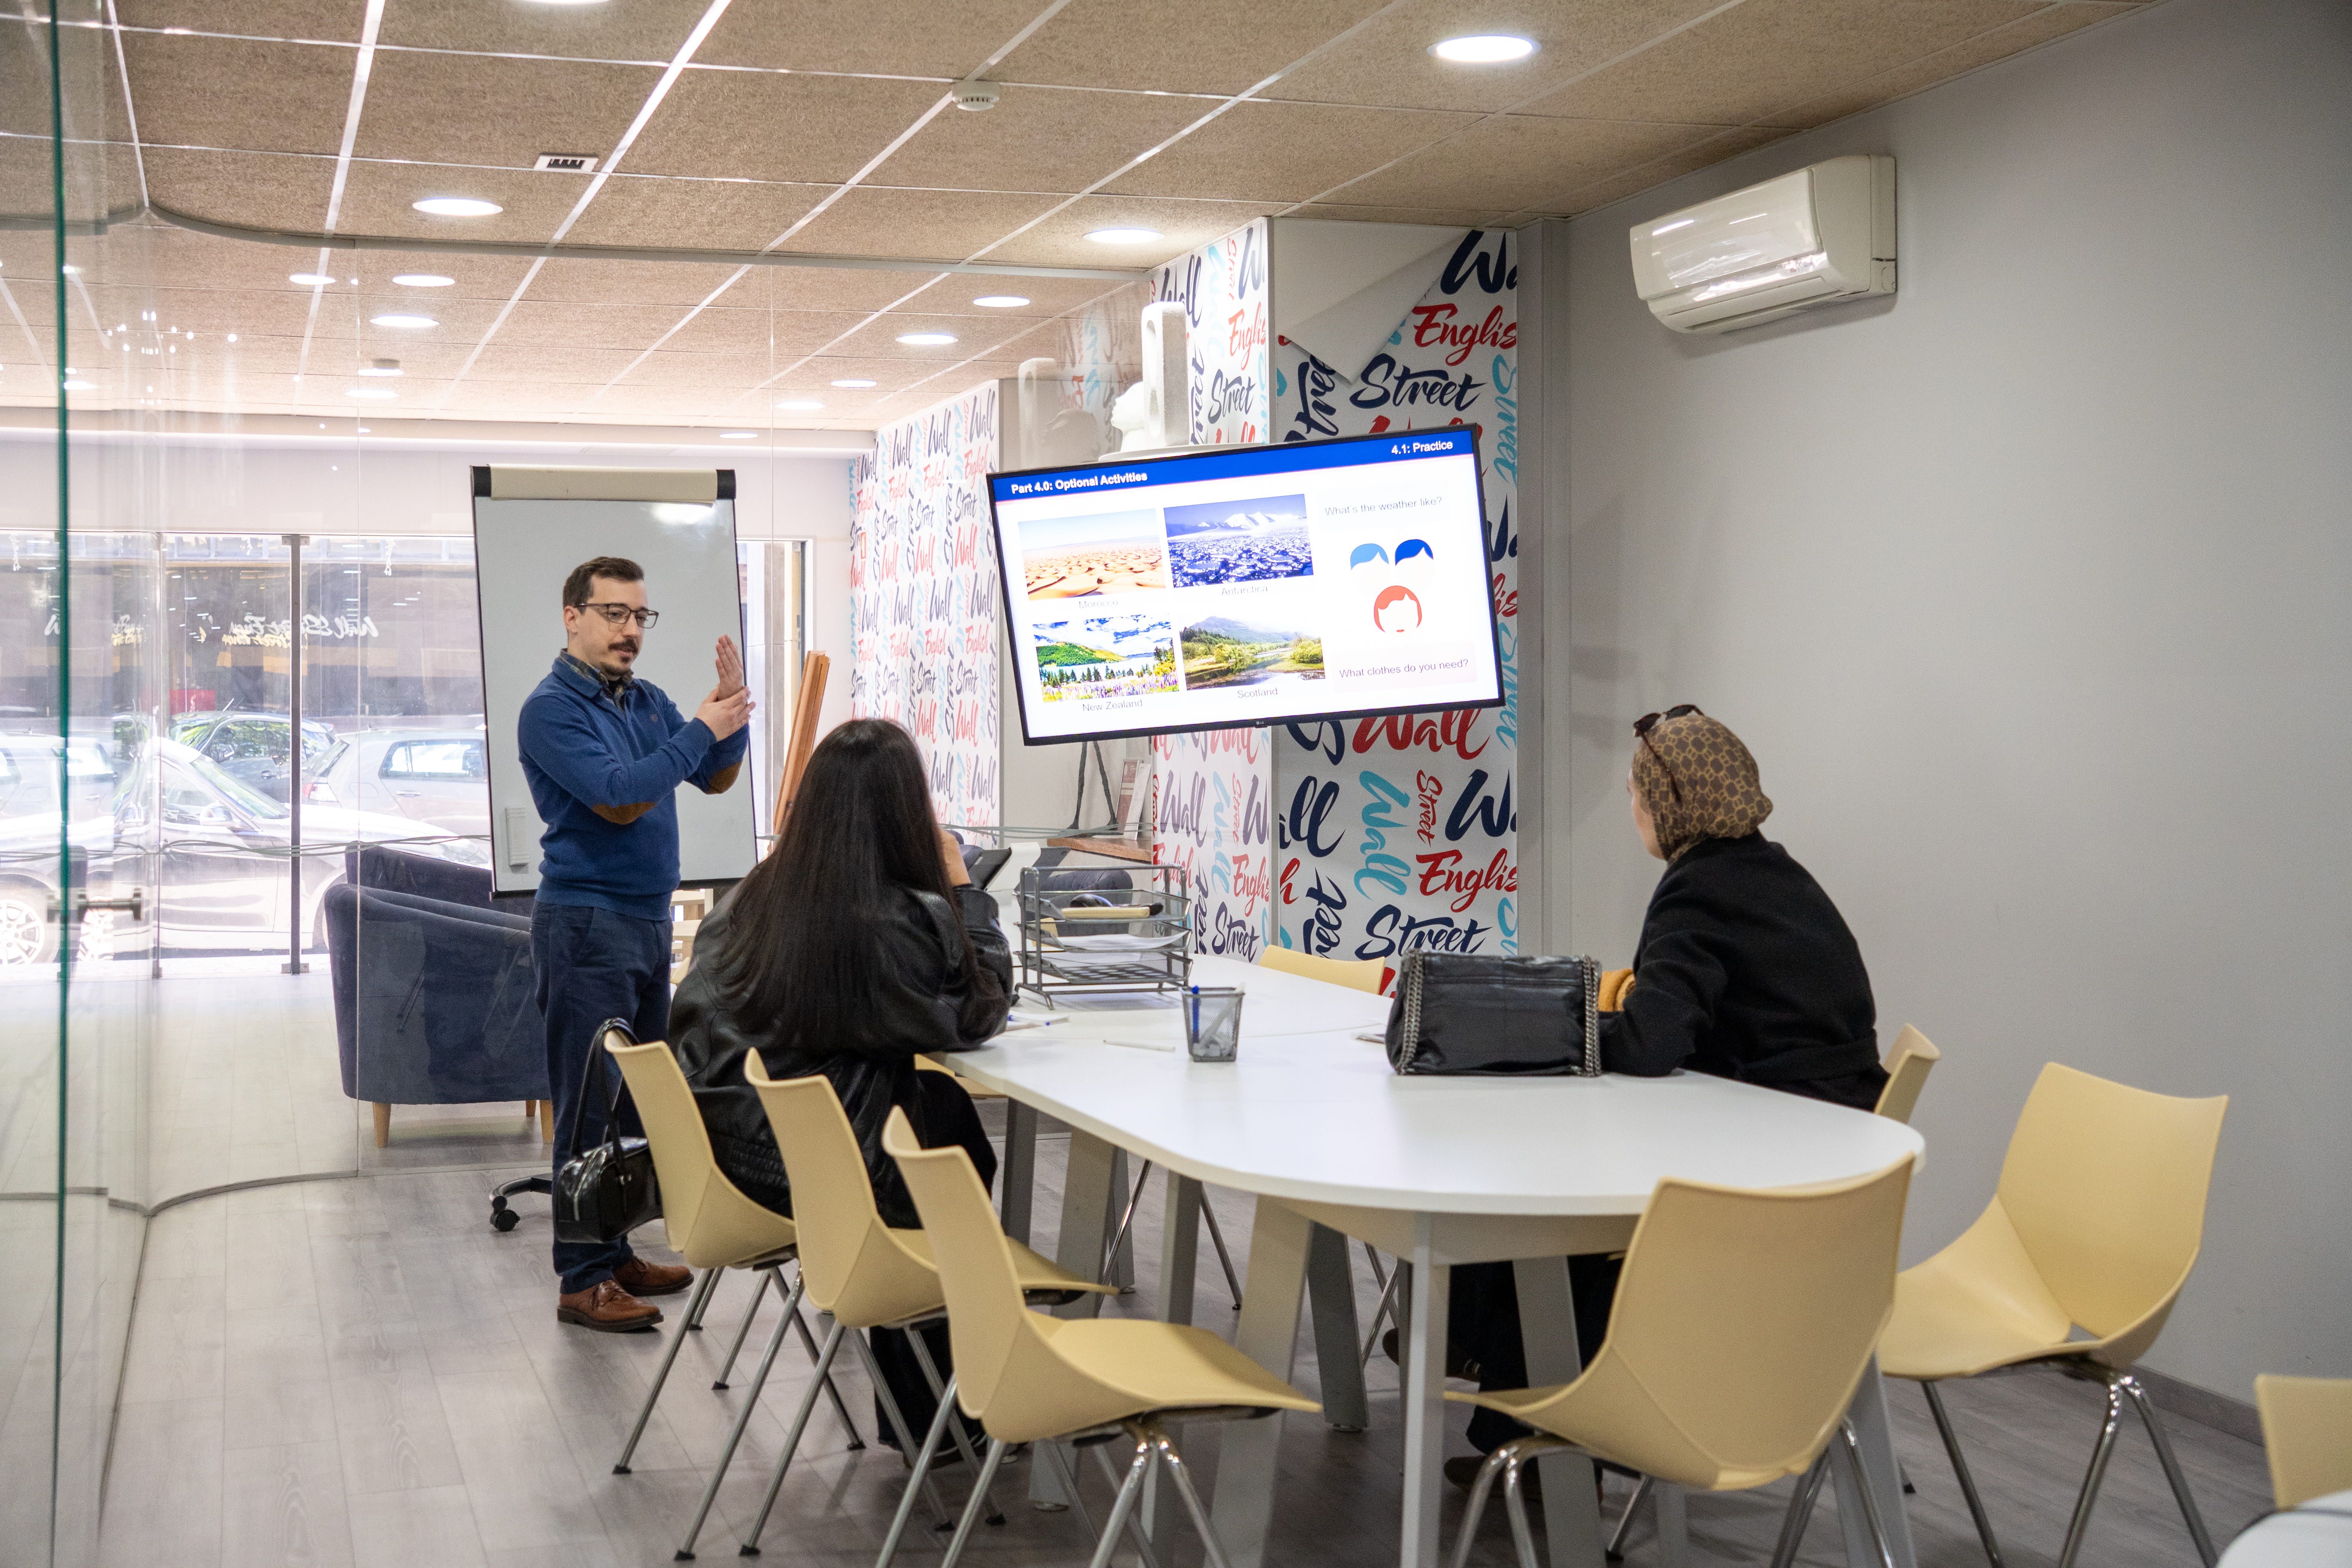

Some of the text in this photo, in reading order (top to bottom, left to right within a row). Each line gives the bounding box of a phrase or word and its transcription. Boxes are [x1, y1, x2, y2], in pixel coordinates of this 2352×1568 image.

[1208, 368, 1257, 424] Street
[1349, 353, 1487, 411] Street
[928, 408, 952, 458] Wall
[970, 389, 996, 443] Wall
[861, 438, 879, 483] Wall
[893, 423, 913, 470] Wall
[964, 444, 988, 490] English
[1391, 441, 1453, 455] 4.1: Practice
[889, 472, 907, 511] English
[923, 459, 945, 501] English
[1011, 472, 1148, 494] Part 4.0: Optional Activities
[882, 509, 899, 541] Street
[915, 498, 935, 531] Street
[955, 487, 978, 522] Street
[1325, 506, 1358, 515] What's
[1378, 500, 1417, 510] weather
[1420, 496, 1442, 506] like?
[882, 542, 899, 584] Wall
[916, 533, 936, 577] Wall
[955, 523, 978, 570] Wall
[850, 555, 866, 592] Wall
[1221, 585, 1268, 596] Antarctica
[862, 592, 880, 636] Wall
[894, 583, 915, 630] Wall
[929, 576, 953, 626] Wall
[971, 570, 996, 623] Wall
[1078, 600, 1118, 609] Morocco
[890, 631, 909, 669] English
[925, 628, 947, 667] English
[966, 624, 989, 665] English
[851, 668, 868, 698] Street
[882, 664, 900, 696] Street
[916, 661, 937, 694] Street
[956, 659, 979, 695] Street
[1339, 669, 1364, 678] What
[1367, 665, 1401, 675] clothes
[1419, 663, 1436, 673] you
[1439, 659, 1468, 669] need?
[1083, 699, 1143, 712] New Zealand
[1237, 687, 1278, 699] Scotland
[917, 699, 937, 744] Wall
[956, 699, 979, 748] Wall
[931, 750, 955, 802] Wall
[972, 754, 997, 809] Wall
[1160, 770, 1208, 847] Wall
[1416, 770, 1443, 847] Street
[1354, 771, 1411, 900] Wall
[1212, 901, 1260, 963] Street
[1355, 904, 1493, 960] Street
